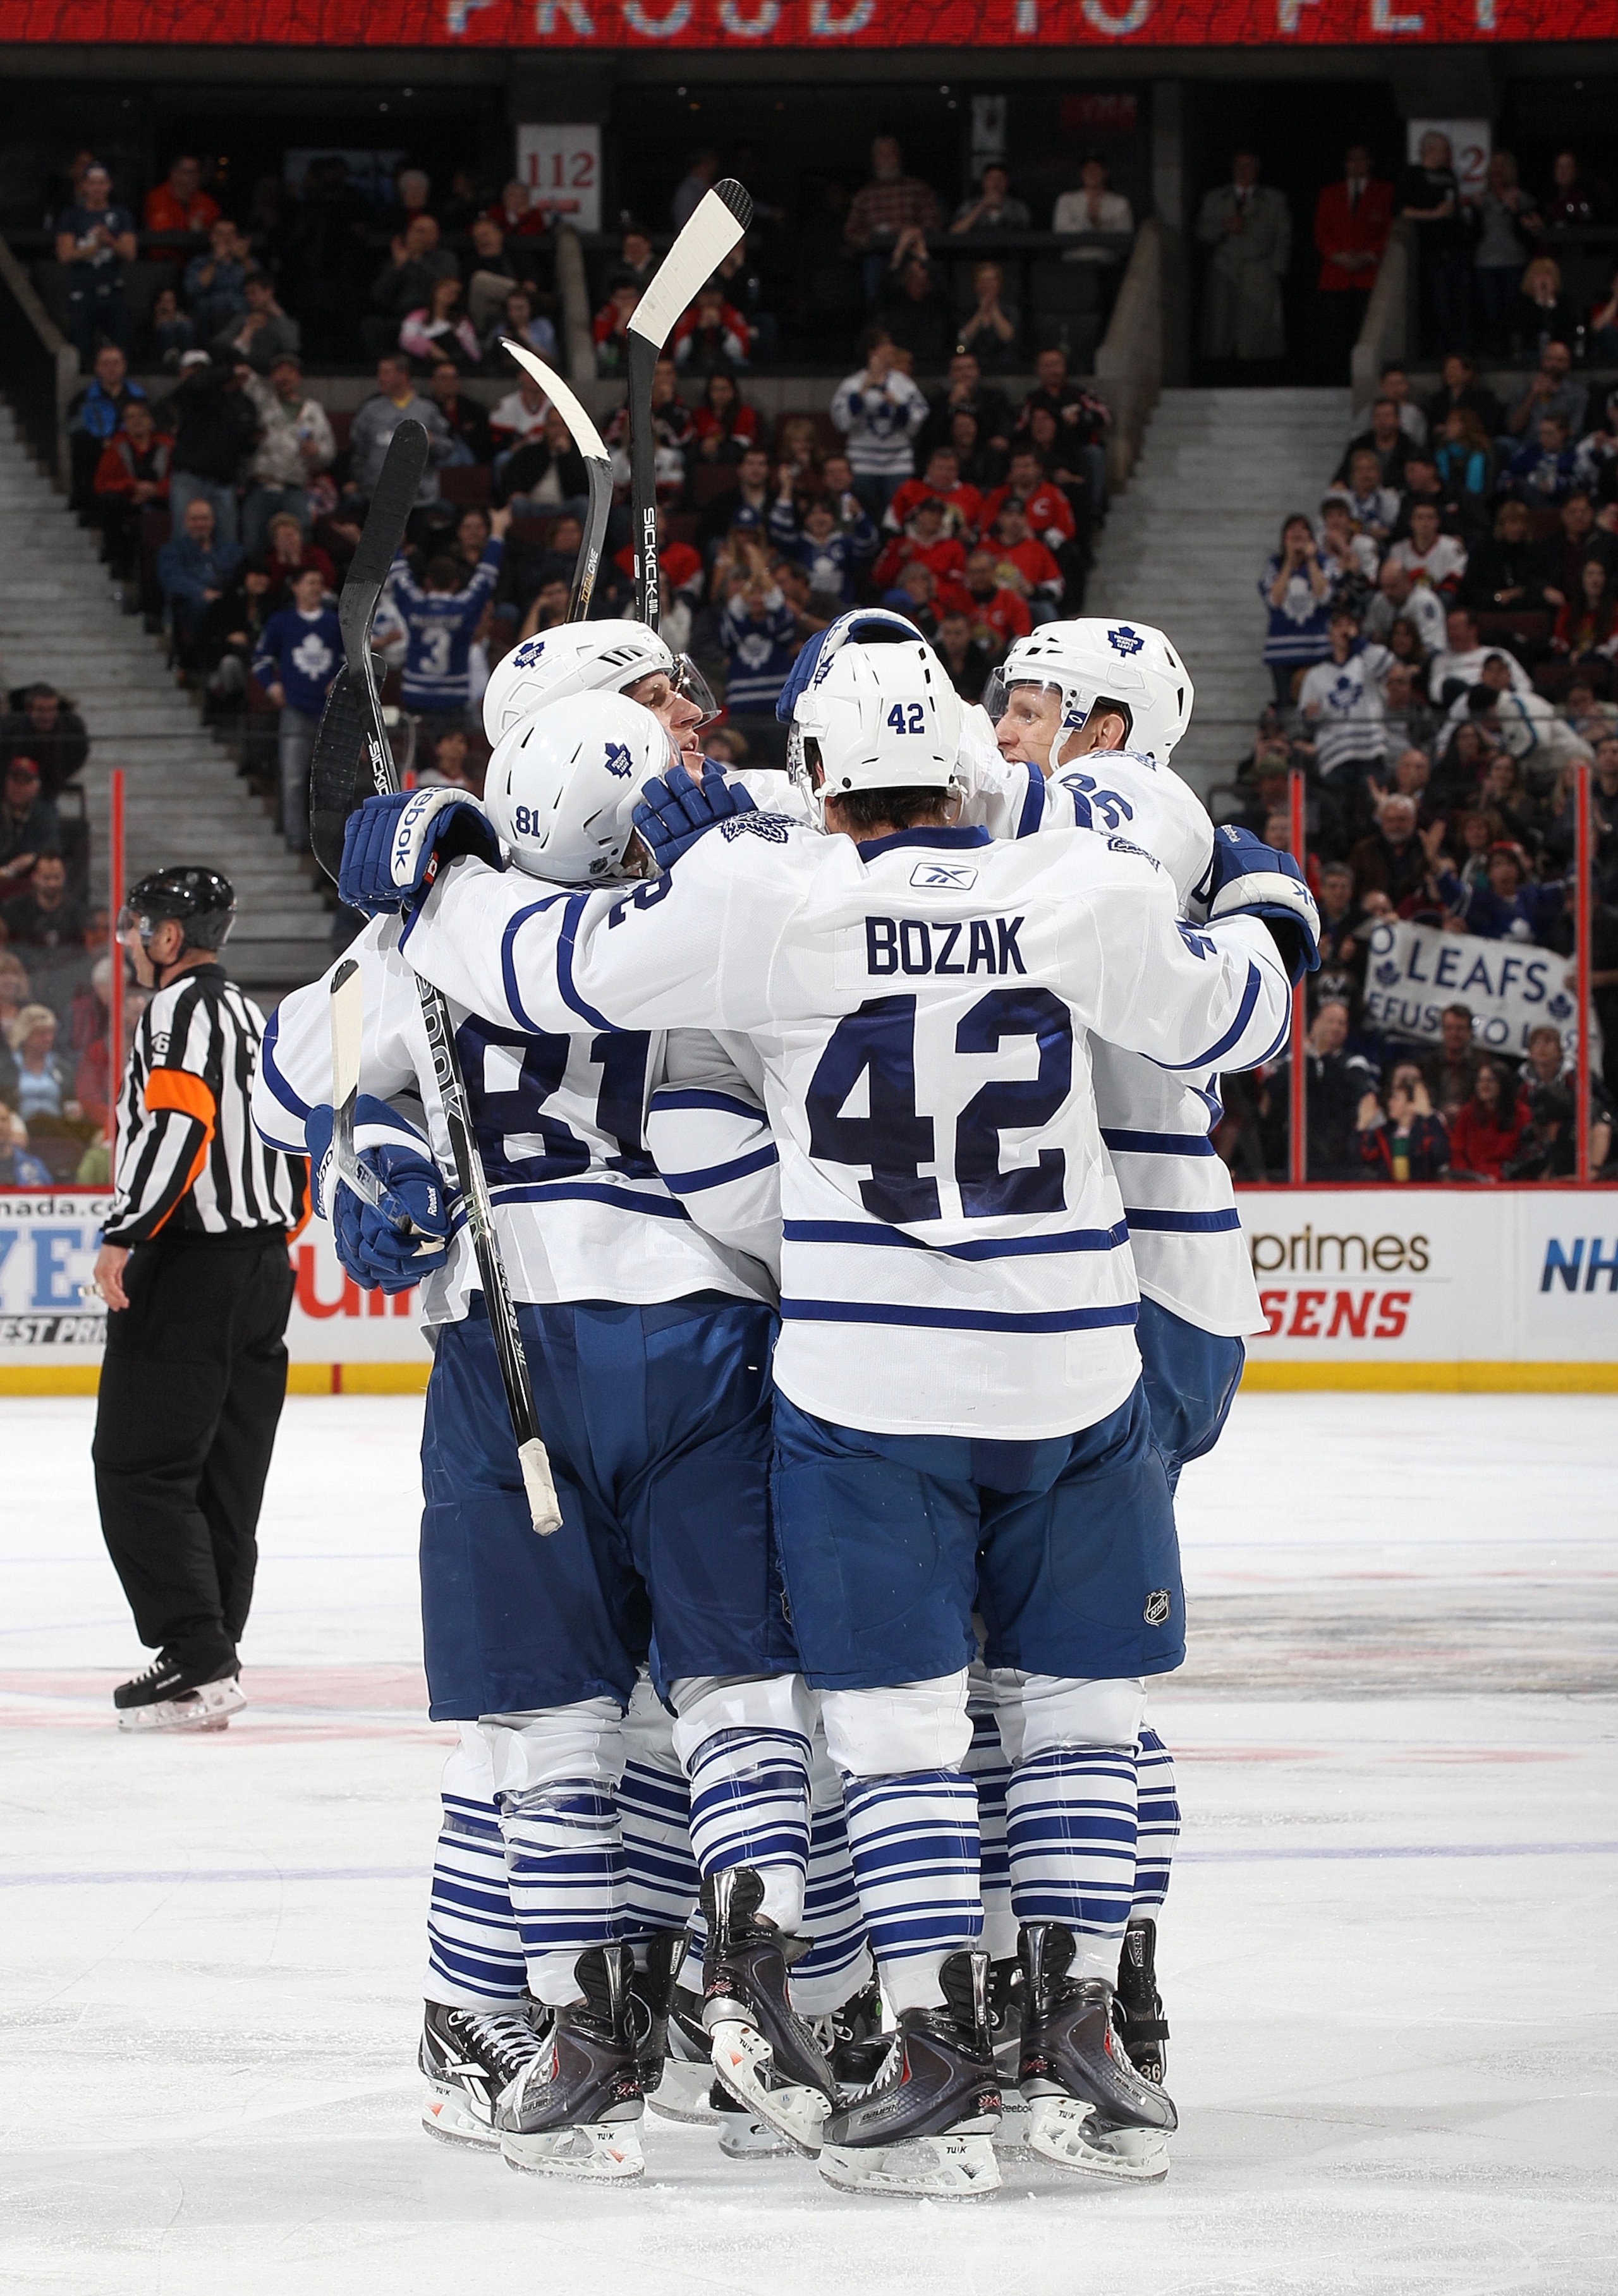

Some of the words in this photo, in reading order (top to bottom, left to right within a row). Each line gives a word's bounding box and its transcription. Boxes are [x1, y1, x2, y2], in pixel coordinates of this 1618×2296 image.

[528, 150, 593, 188] 112
[588, 547, 599, 575] ONE
[643, 507, 658, 595] SICKICK
[419, 626, 451, 674] 3
[888, 703, 925, 734] 42
[516, 806, 540, 837] 81
[865, 916, 1027, 975] BOZAK
[1407, 939, 1548, 1003] LEAFS
[1368, 992, 1440, 1033] EFUS
[455, 1012, 661, 1183] 81
[805, 987, 1073, 1224] 42
[427, 1186, 437, 1217] Reebok
[1250, 1224, 1429, 1280] primes
[1541, 1239, 1618, 1292] NH
[1249, 1291, 1411, 1337] SENS
[1140, 2065, 1160, 2084] 36
